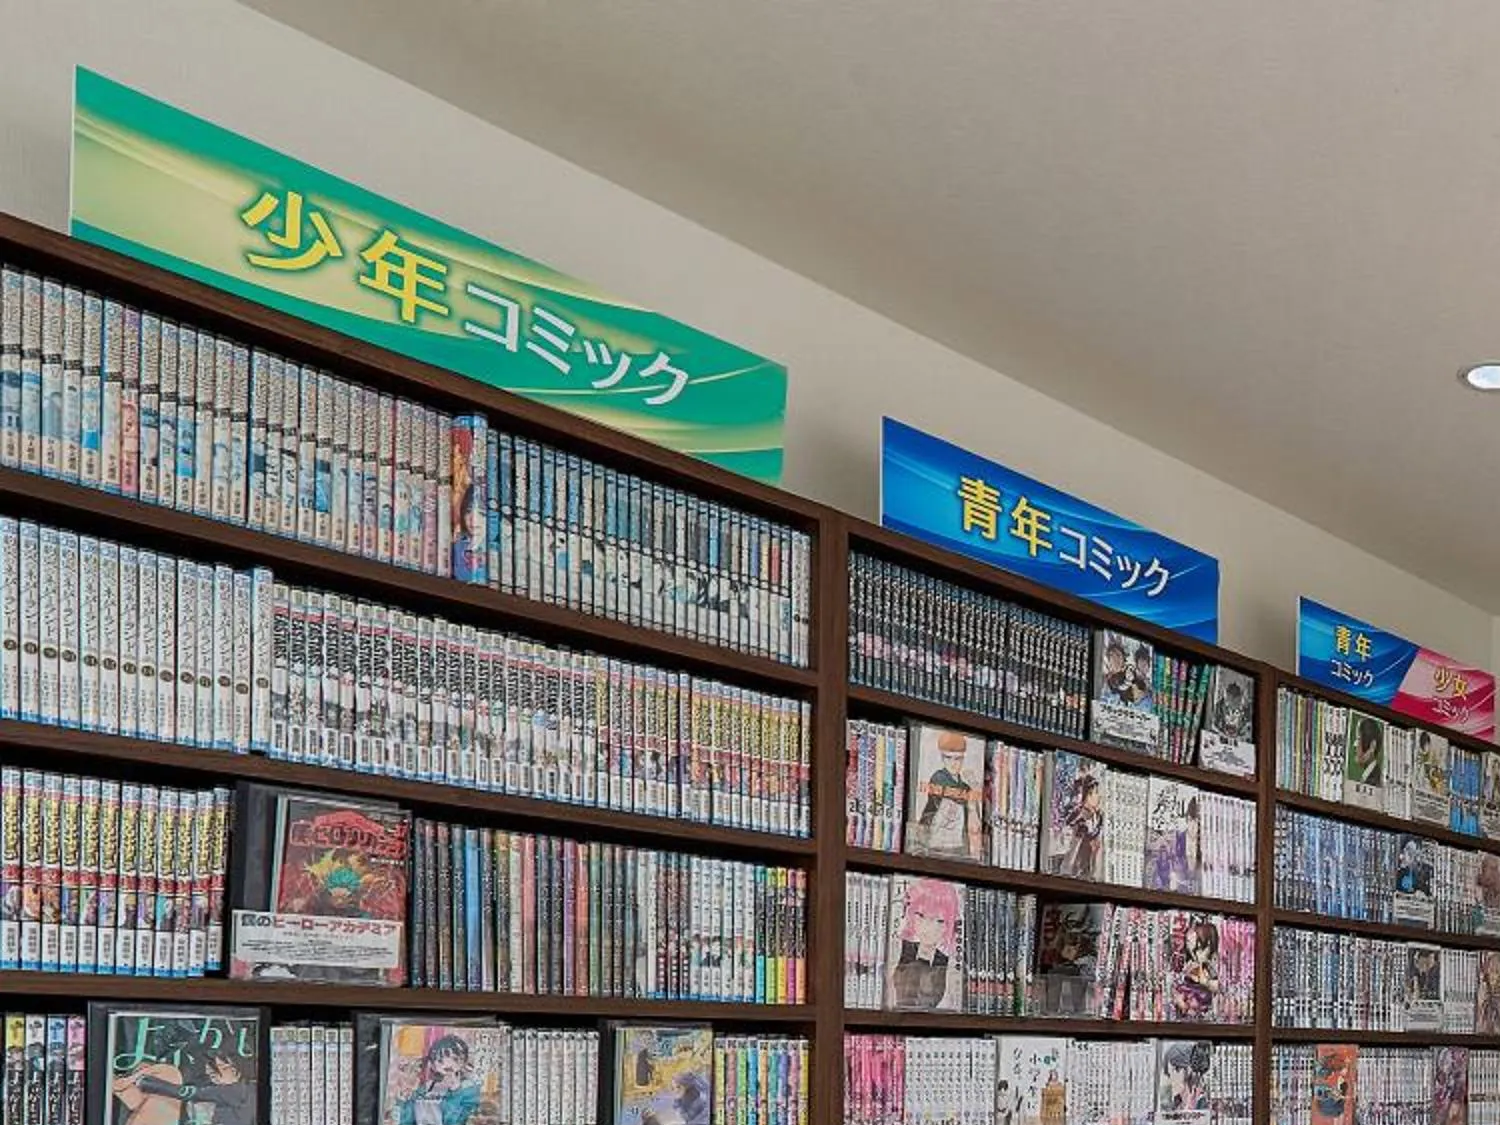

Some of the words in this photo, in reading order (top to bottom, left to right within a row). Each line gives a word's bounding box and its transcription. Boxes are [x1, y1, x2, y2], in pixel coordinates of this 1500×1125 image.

[241, 190, 690, 405] 少年コミック
[956, 475, 1170, 597] 青年コミック
[1336, 624, 1373, 662] 青年
[1331, 660, 1374, 687] コミック
[1434, 666, 1468, 699] 少女
[1433, 699, 1470, 723] コミック
